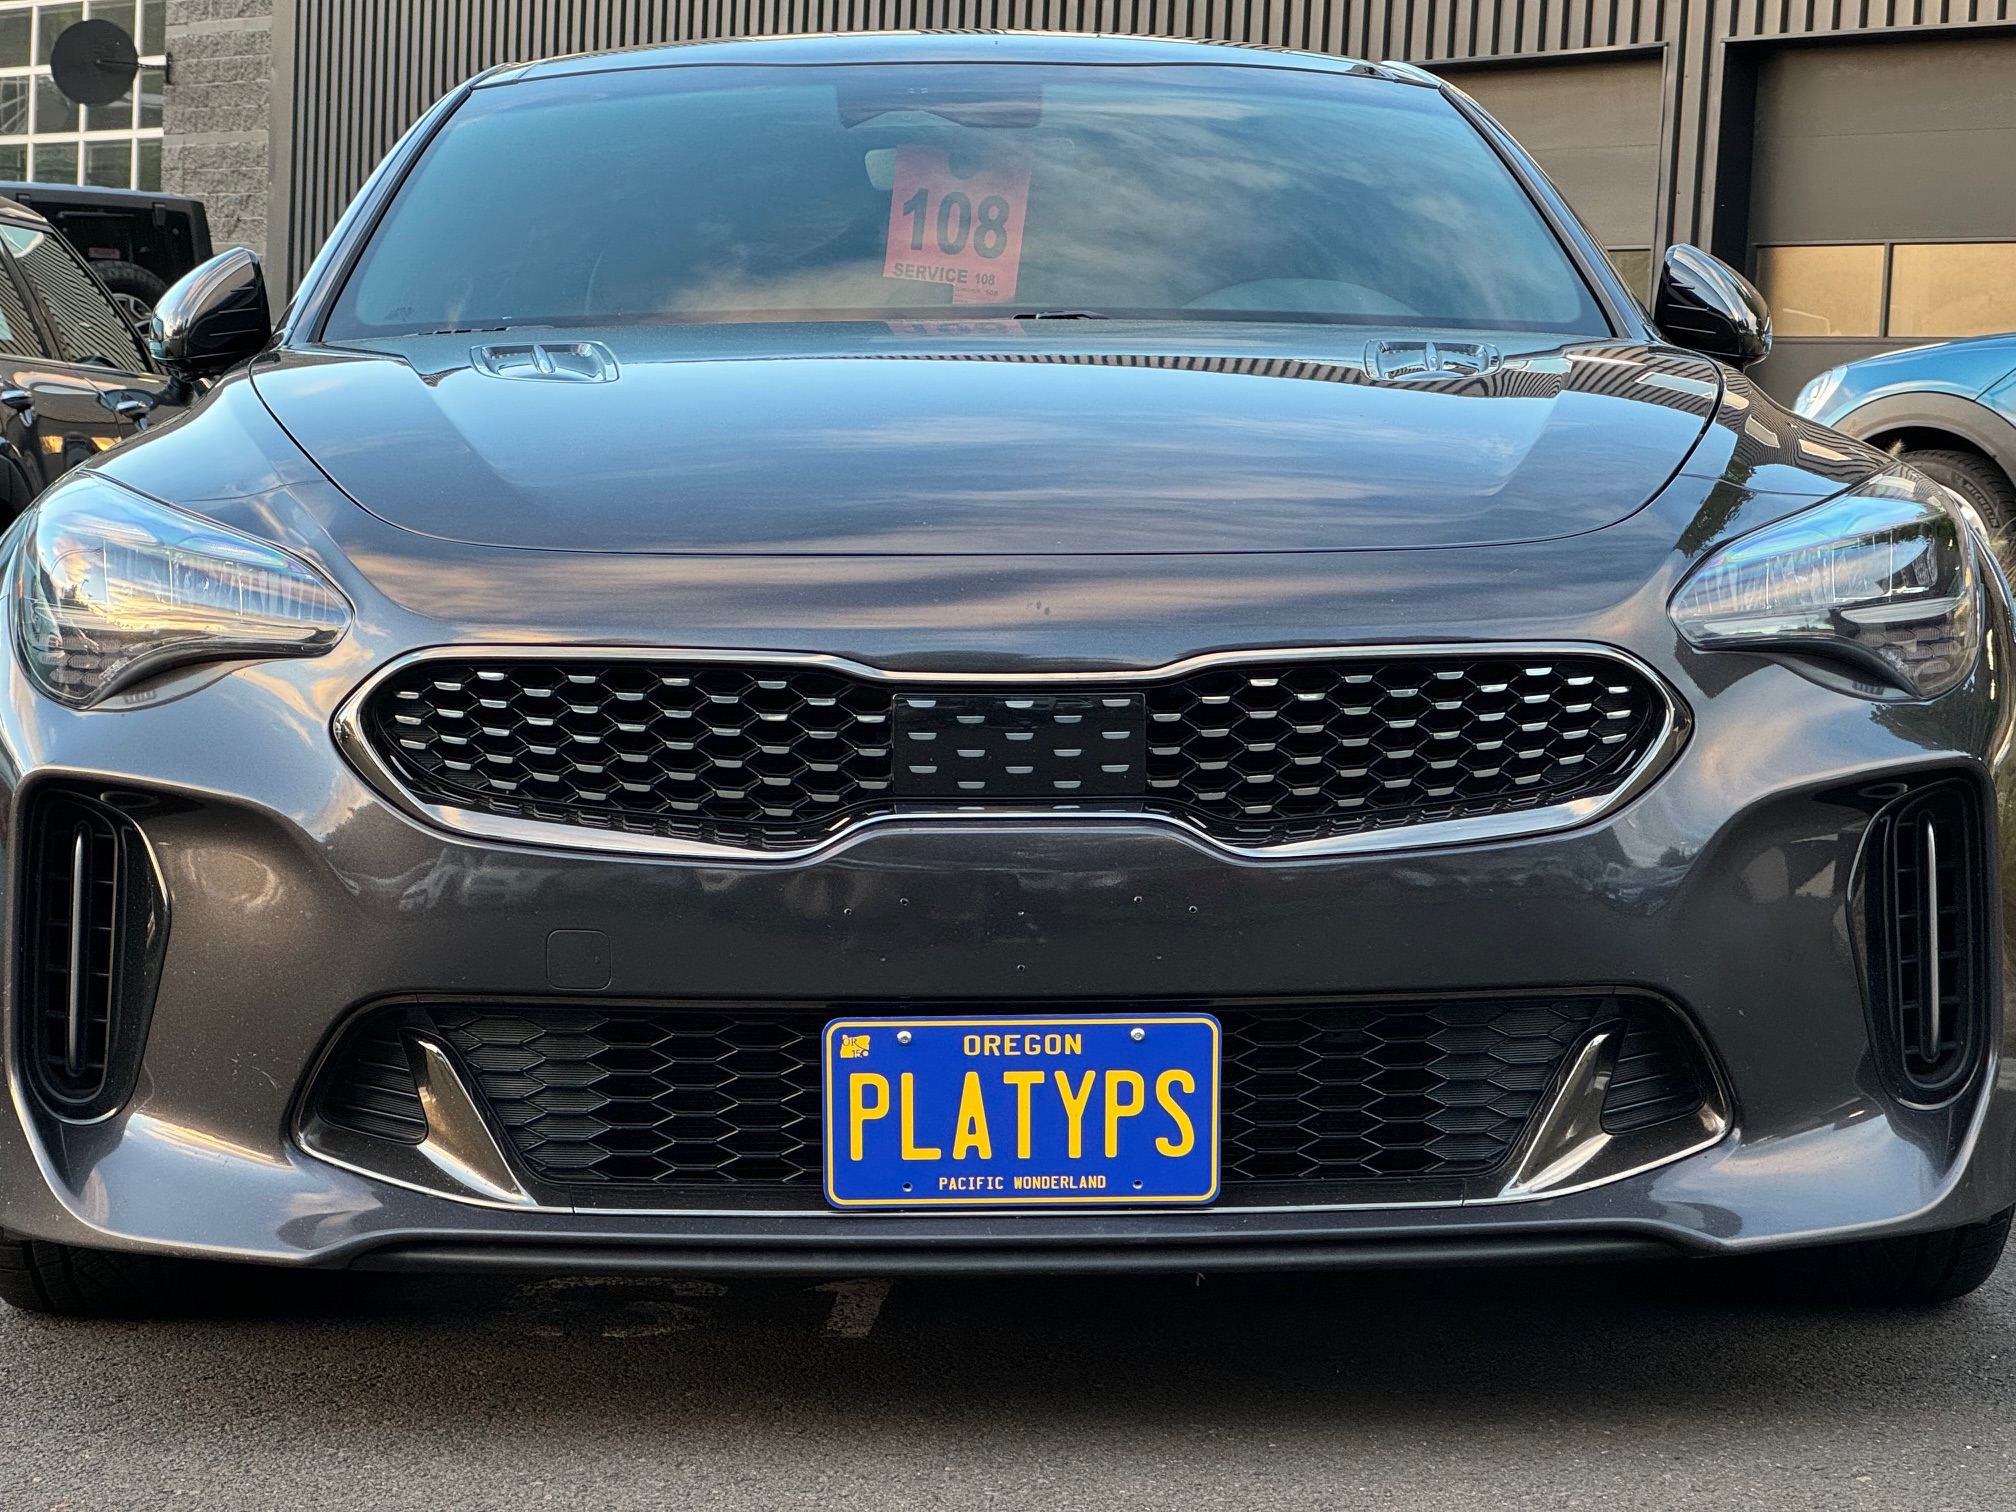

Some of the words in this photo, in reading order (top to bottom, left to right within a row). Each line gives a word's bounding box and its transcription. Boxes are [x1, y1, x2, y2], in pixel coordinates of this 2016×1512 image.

[902, 187, 1010, 260] 108
[892, 262, 969, 284] SERVICE
[975, 272, 996, 286] 108
[1962, 481, 2000, 529] MICHELIN
[963, 1033, 1082, 1056] OREGON
[849, 1069, 1196, 1162] PLATYPS
[938, 1176, 1004, 1191] PACIFIC
[1013, 1174, 1107, 1190] WONDERLAND
